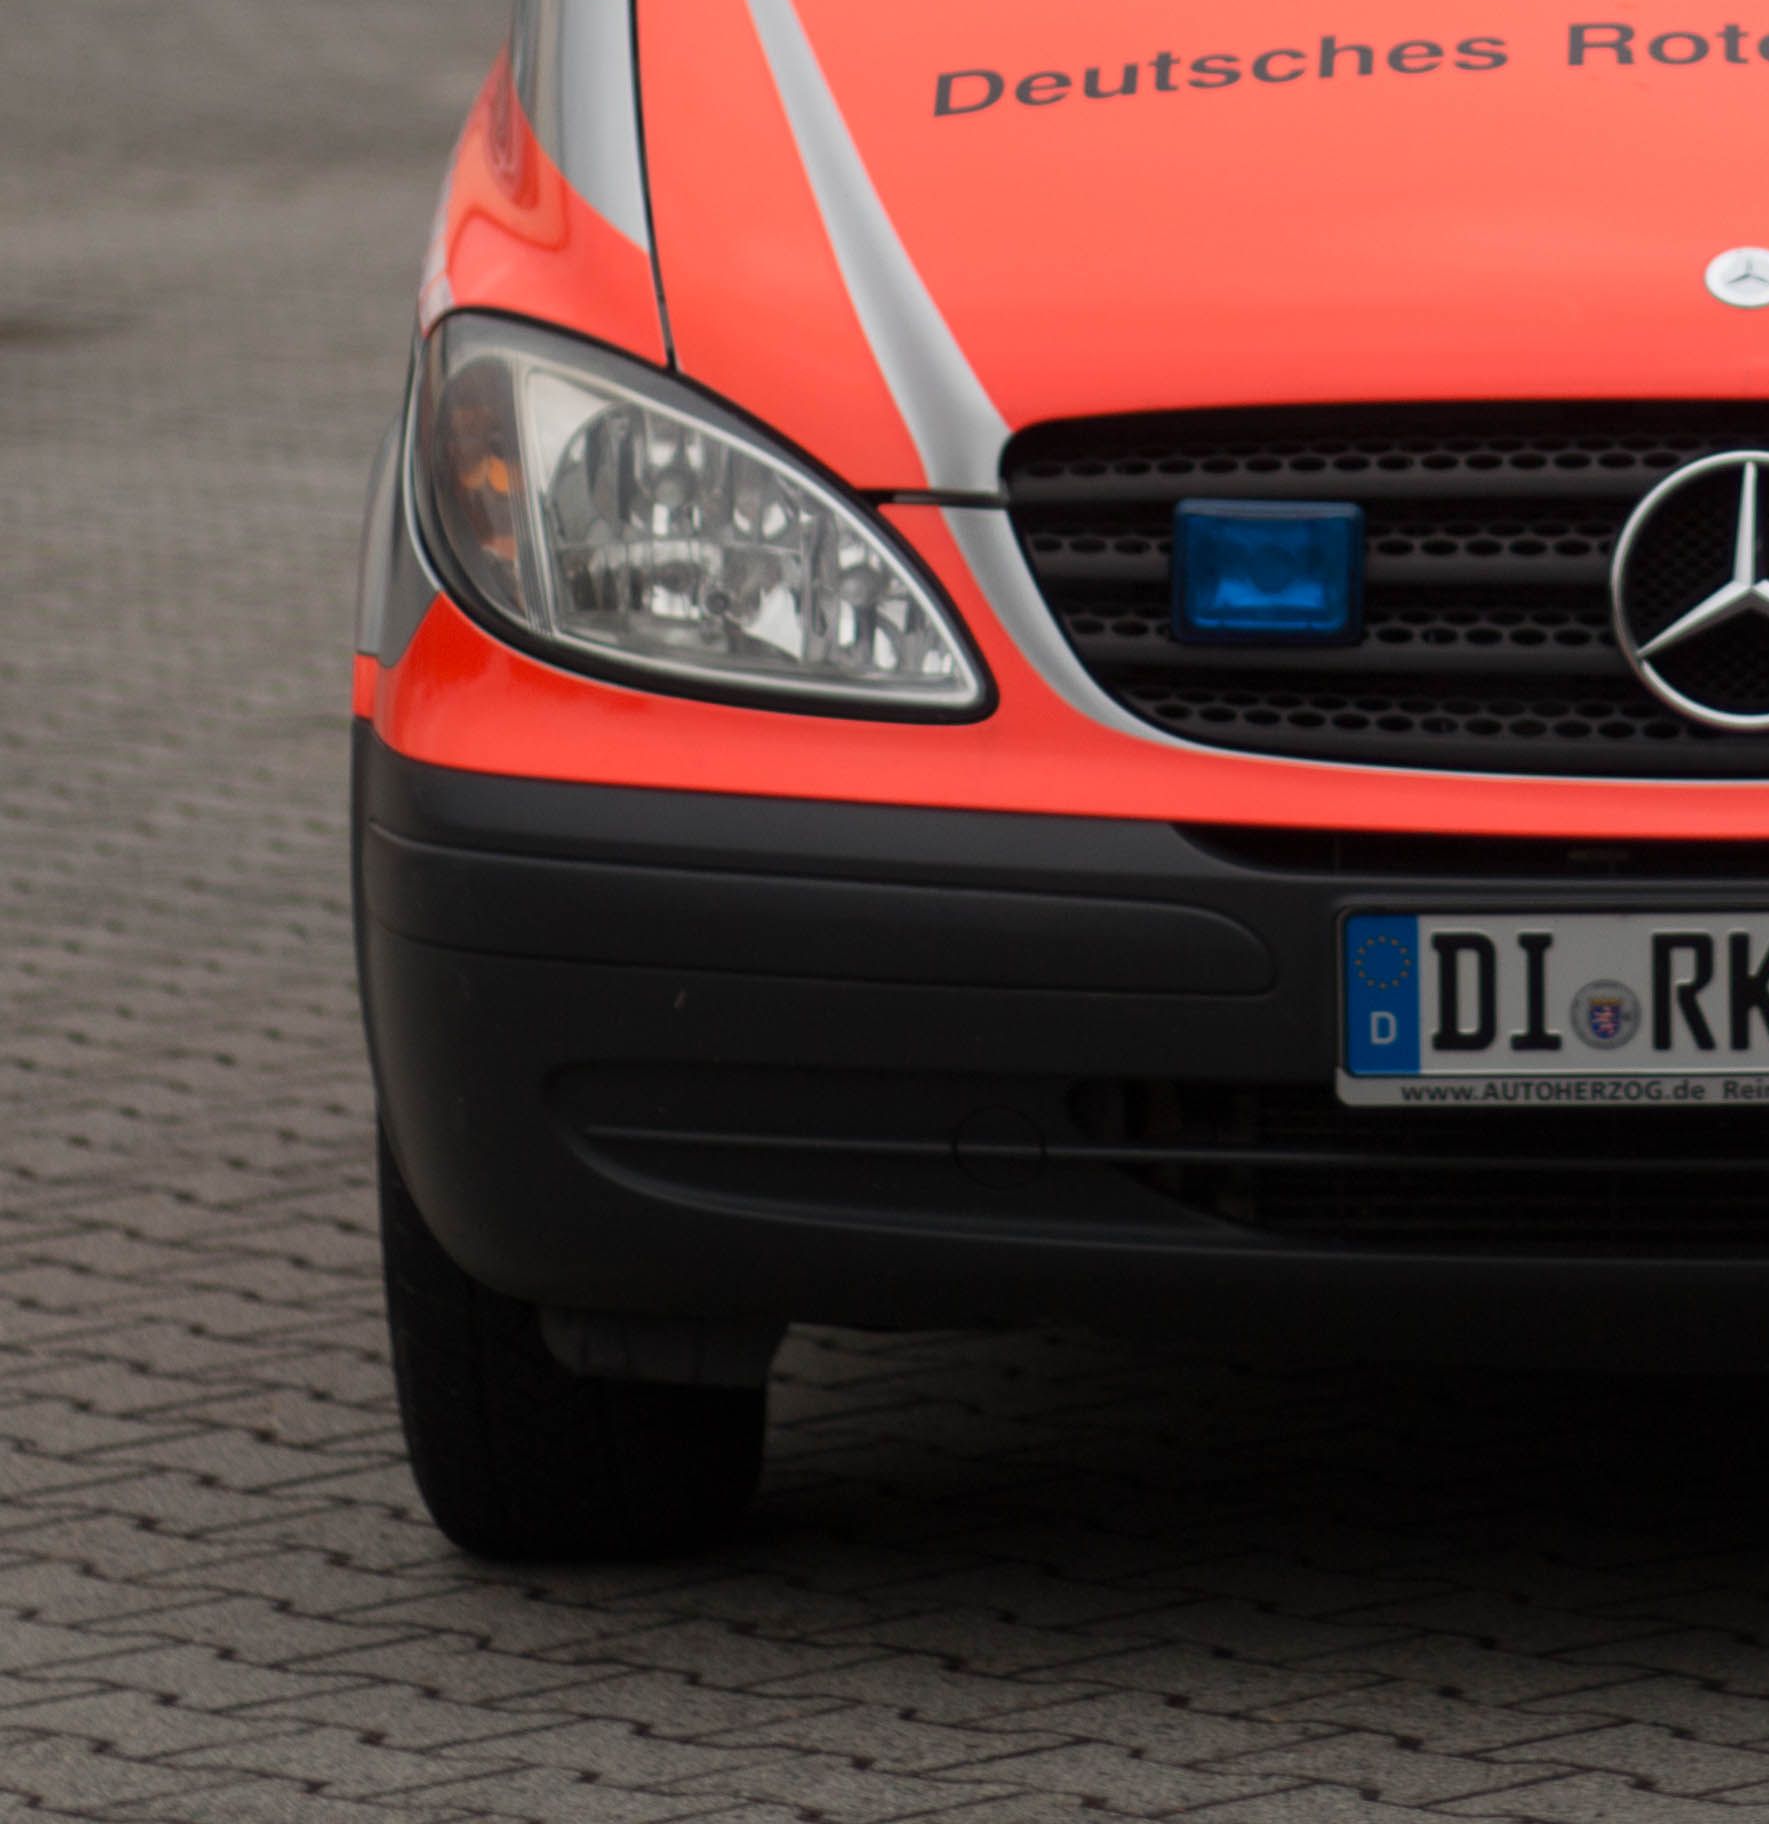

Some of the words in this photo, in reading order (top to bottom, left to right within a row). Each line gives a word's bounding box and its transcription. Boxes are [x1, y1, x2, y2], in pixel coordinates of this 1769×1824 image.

[933, 34, 1509, 116] Deutsches
[1432, 933, 1562, 1050] DI
[1370, 1011, 1397, 1045] D
[1401, 1079, 1706, 1102] www.AUTOHERZOG.de
